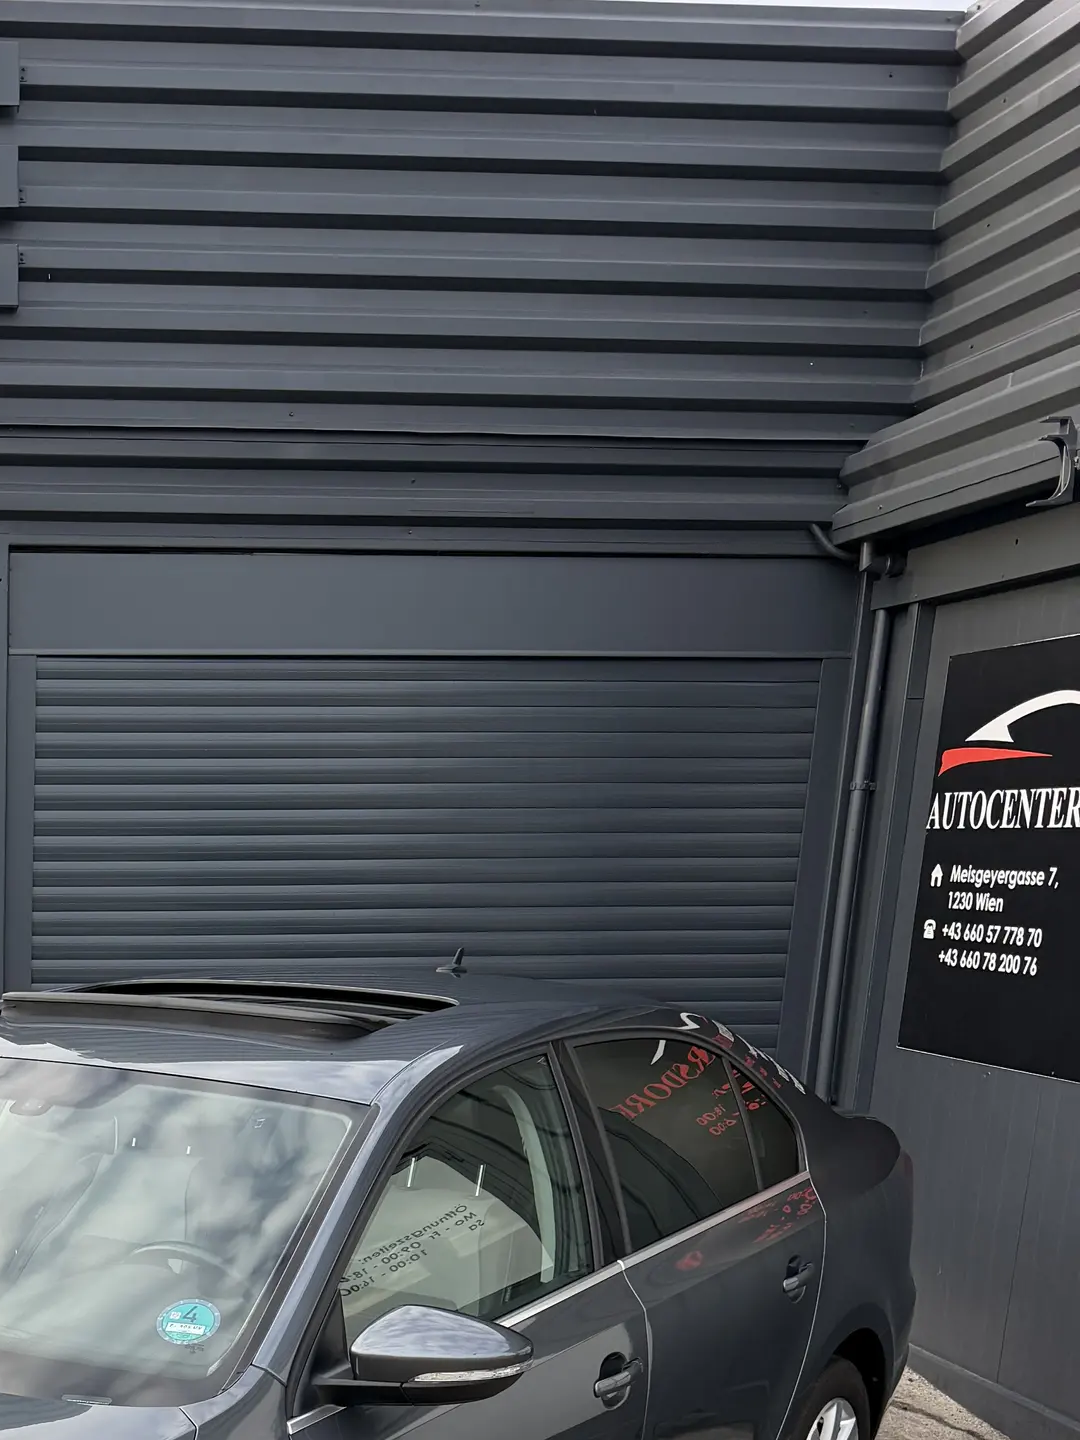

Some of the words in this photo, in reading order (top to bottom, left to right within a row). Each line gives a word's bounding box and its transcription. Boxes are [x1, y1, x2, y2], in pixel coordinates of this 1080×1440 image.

[925, 787, 1080, 830] AUTOCENTER
[949, 864, 1045, 890] Meisgeyergasse
[1047, 867, 1059, 889] 7,
[948, 891, 974, 911] 1230
[975, 892, 1004, 912] Wien
[942, 921, 962, 941] +43
[963, 923, 984, 943] 660
[985, 925, 1001, 944] 57
[1002, 926, 1024, 947] 778
[1026, 928, 1043, 948] 70
[938, 948, 958, 967] +43
[959, 950, 980, 970] 660
[982, 952, 997, 971] 78
[998, 953, 1021, 974] 200
[1022, 956, 1038, 976] 76
